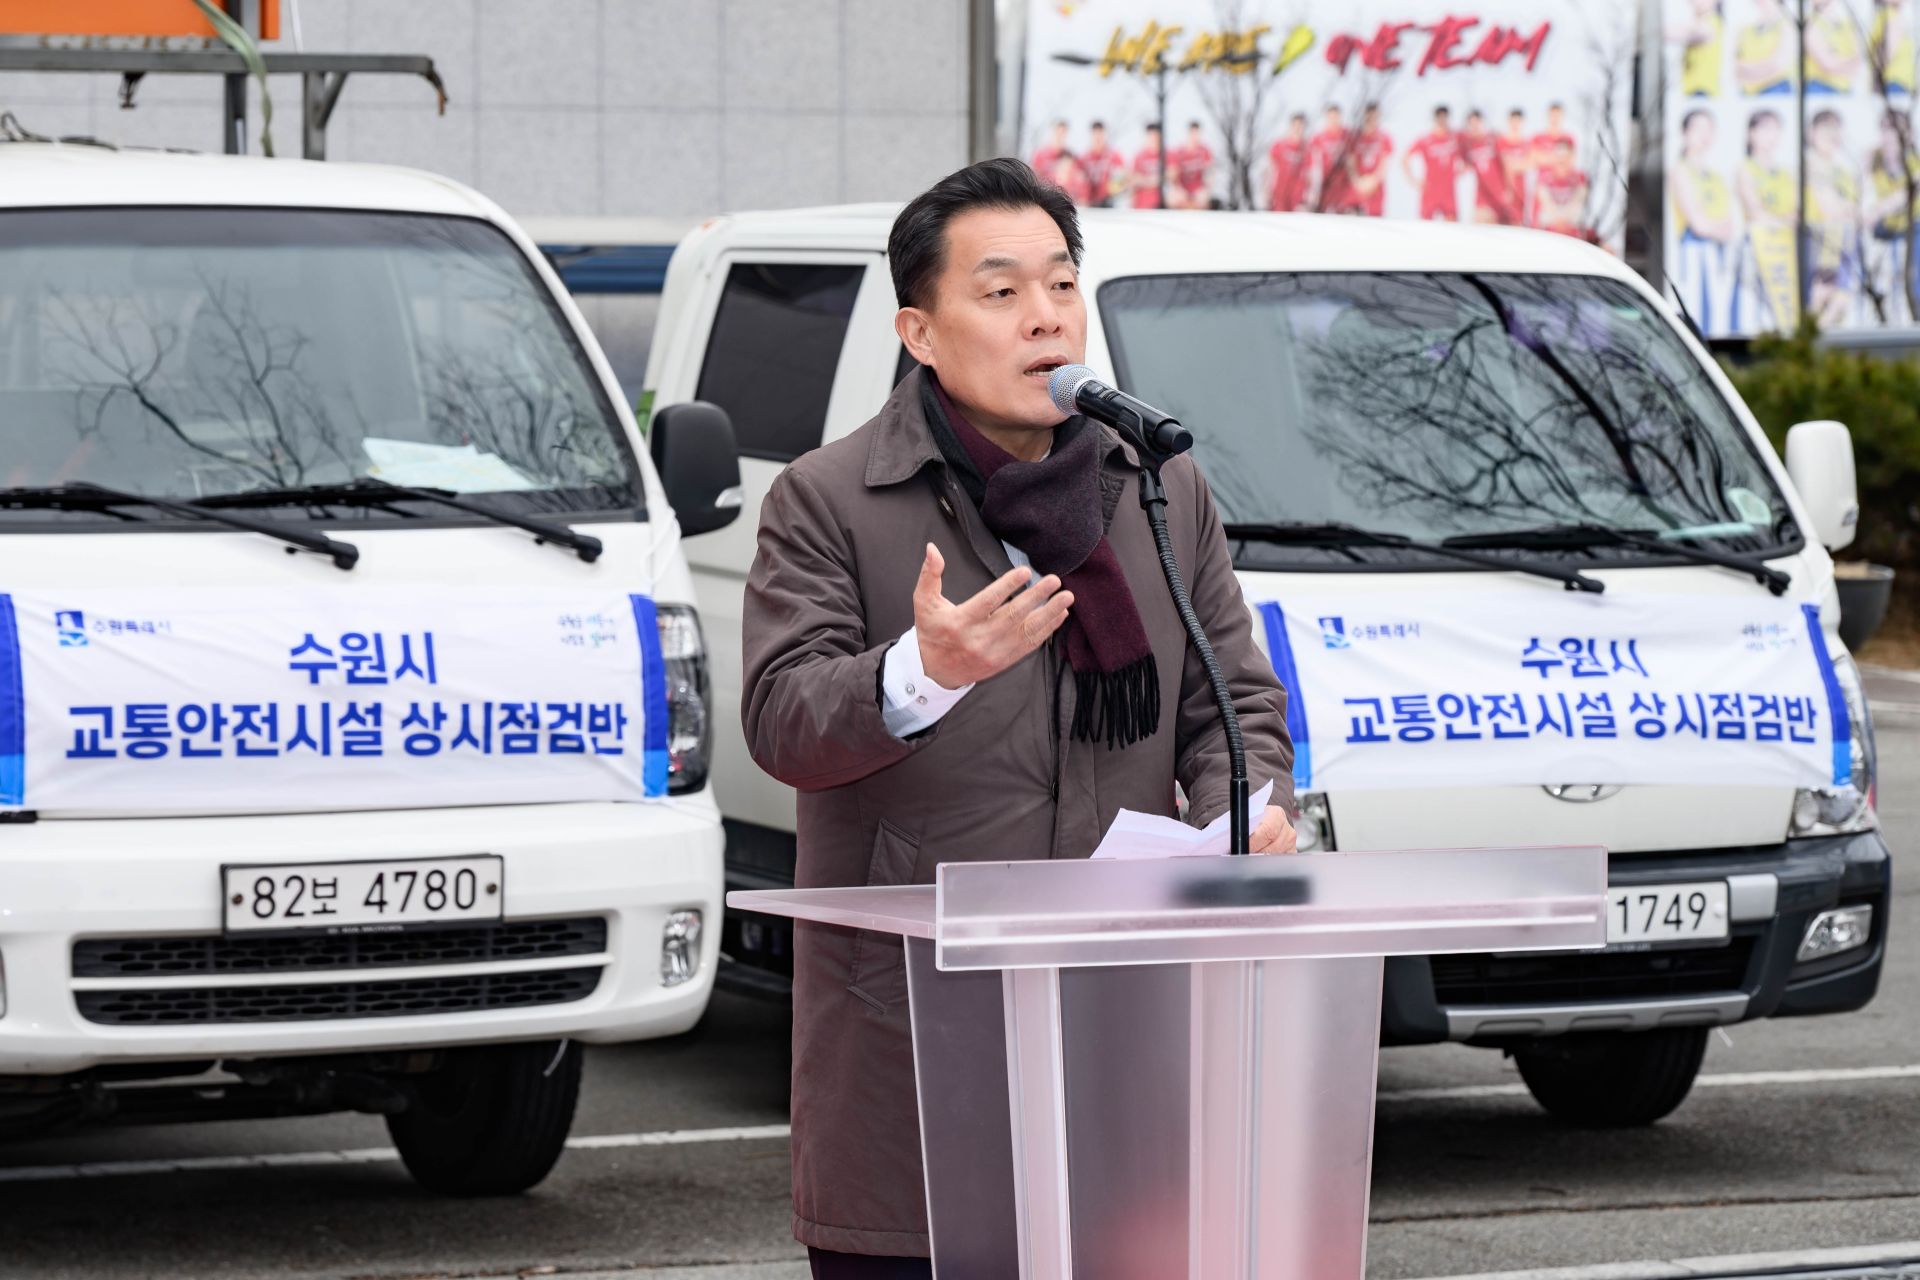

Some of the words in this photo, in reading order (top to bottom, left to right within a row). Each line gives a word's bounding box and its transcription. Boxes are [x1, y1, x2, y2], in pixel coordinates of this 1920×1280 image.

[1098, 19, 1182, 77] WE
[1325, 23, 1414, 75] ONE
[1415, 15, 1551, 77] TEAM
[289, 630, 438, 685] 수원시
[1520, 636, 1651, 679] 수원시
[65, 701, 383, 760] 교통안전시설
[400, 700, 628, 757] 상시점검반
[1343, 692, 1619, 744] 교통안전시설
[1629, 692, 1818, 744] 상시점검반
[252, 874, 338, 919] 82보
[363, 868, 477, 914] 4780
[1616, 891, 1707, 934] 1749
